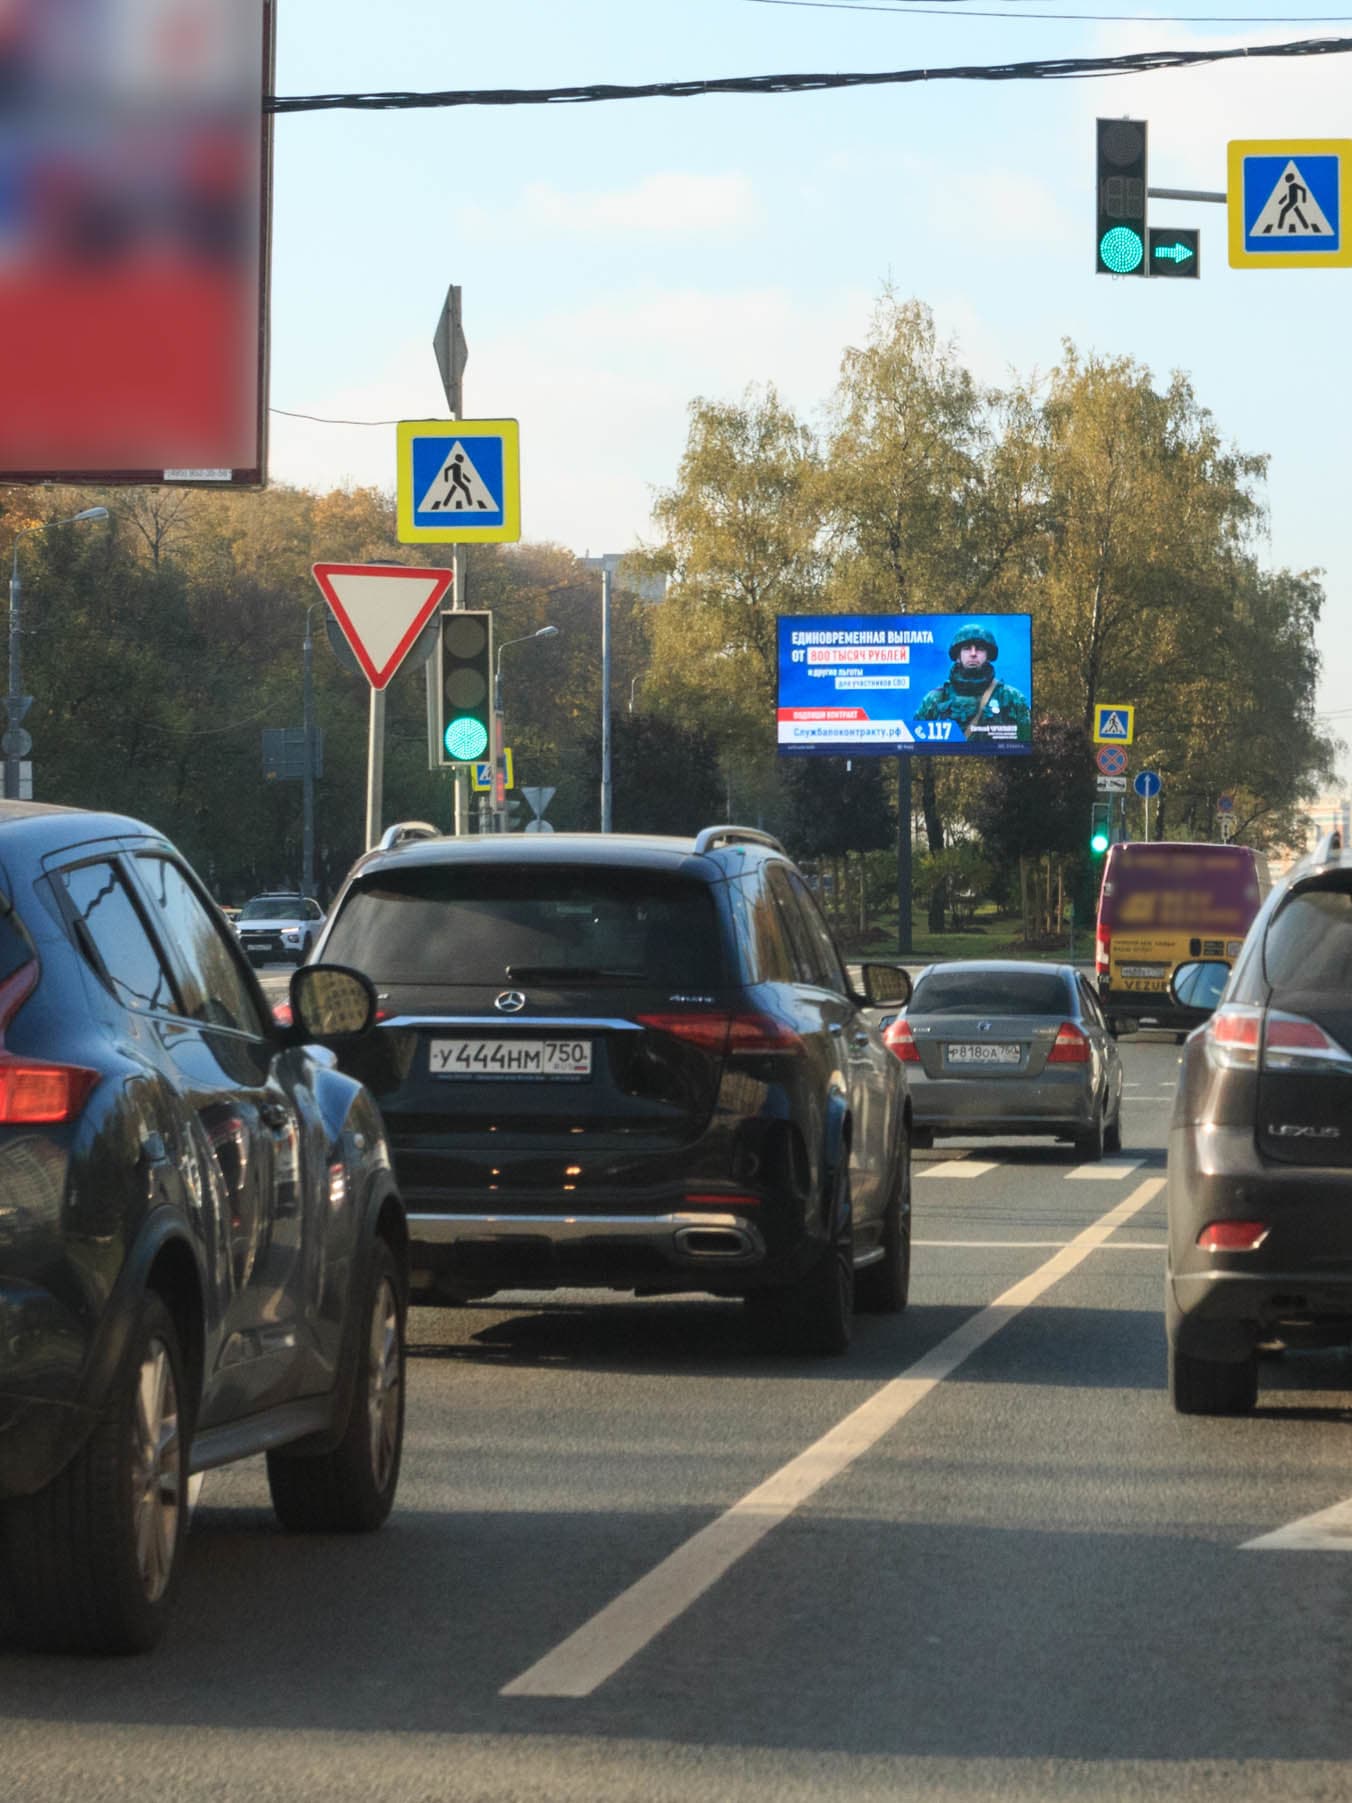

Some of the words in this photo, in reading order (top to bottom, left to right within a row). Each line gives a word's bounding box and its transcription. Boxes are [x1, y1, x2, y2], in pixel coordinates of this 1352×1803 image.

[792, 631, 886, 645] ЕДИНОВРЕМЕННАЯ
[888, 630, 934, 644] ВЫПЛАТА
[792, 649, 805, 662] ОТ
[810, 649, 830, 661] 800
[833, 649, 866, 661] ТЫСЯЧ
[869, 647, 907, 661] РУБЛЕЙ
[793, 727, 902, 738] Службапоконтракту.рф
[927, 722, 952, 740] 117
[440, 1043, 541, 1069] У444НМ
[1268, 1124, 1340, 1138] LEXUS
